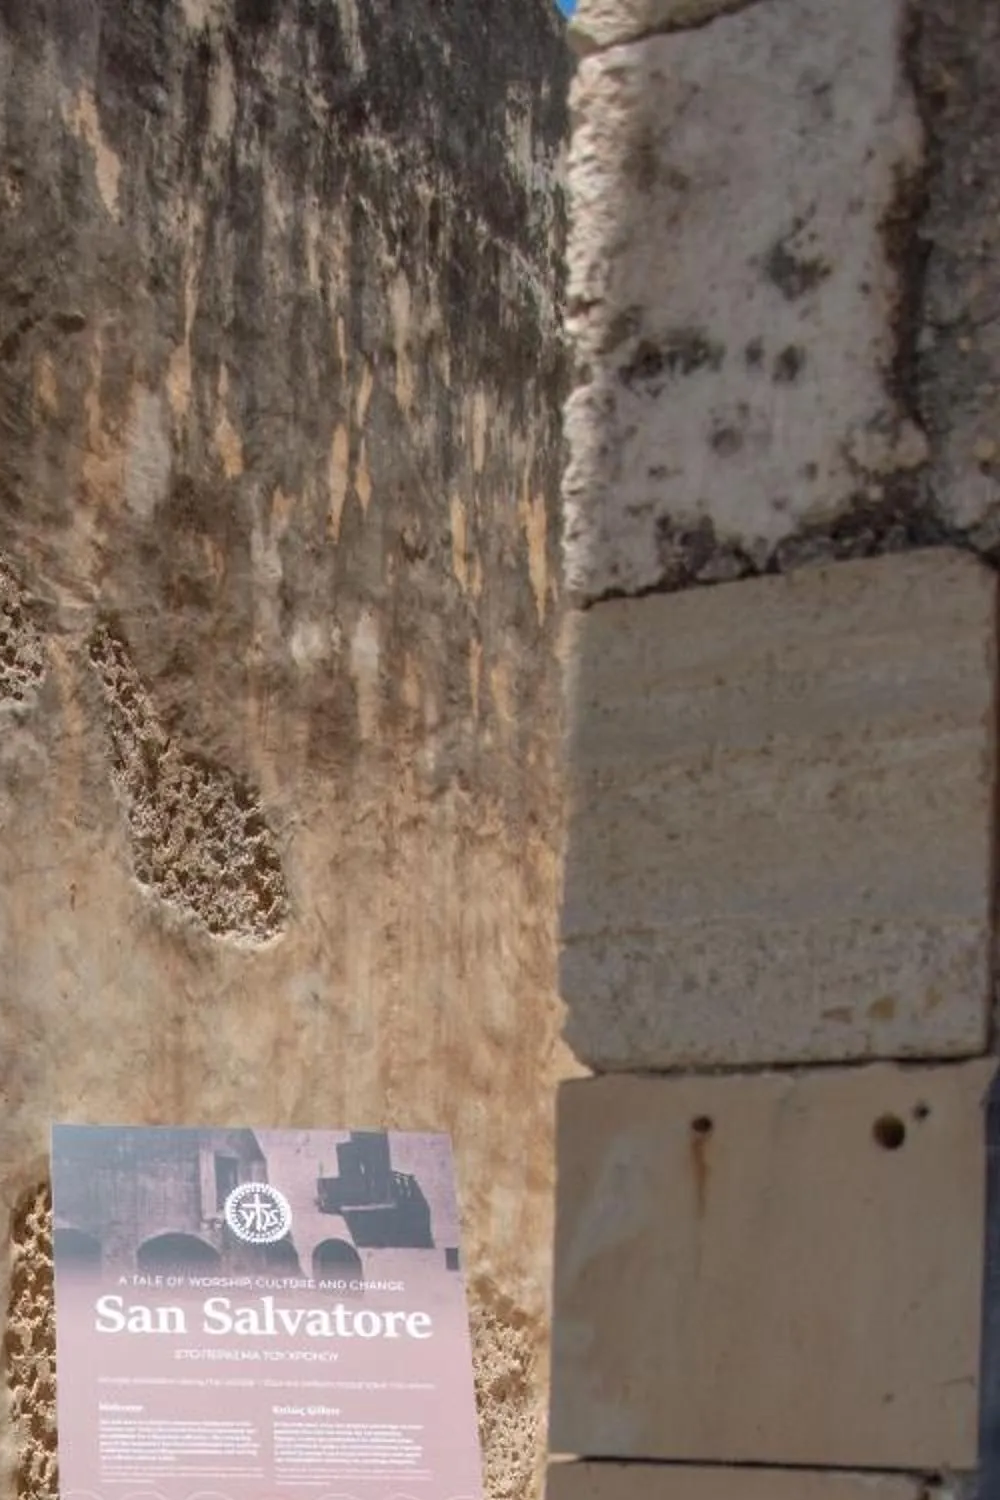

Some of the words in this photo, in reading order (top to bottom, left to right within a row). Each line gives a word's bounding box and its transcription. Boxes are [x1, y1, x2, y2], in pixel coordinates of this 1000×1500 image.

[118, 1275, 128, 1286] A
[132, 1275, 163, 1287] TALE
[166, 1276, 184, 1287] OF
[256, 1277, 317, 1290] CULTURE
[319, 1279, 347, 1290] AND
[349, 1279, 405, 1292] CHANGE
[95, 1294, 188, 1334] San
[203, 1296, 434, 1339] Salvatore
